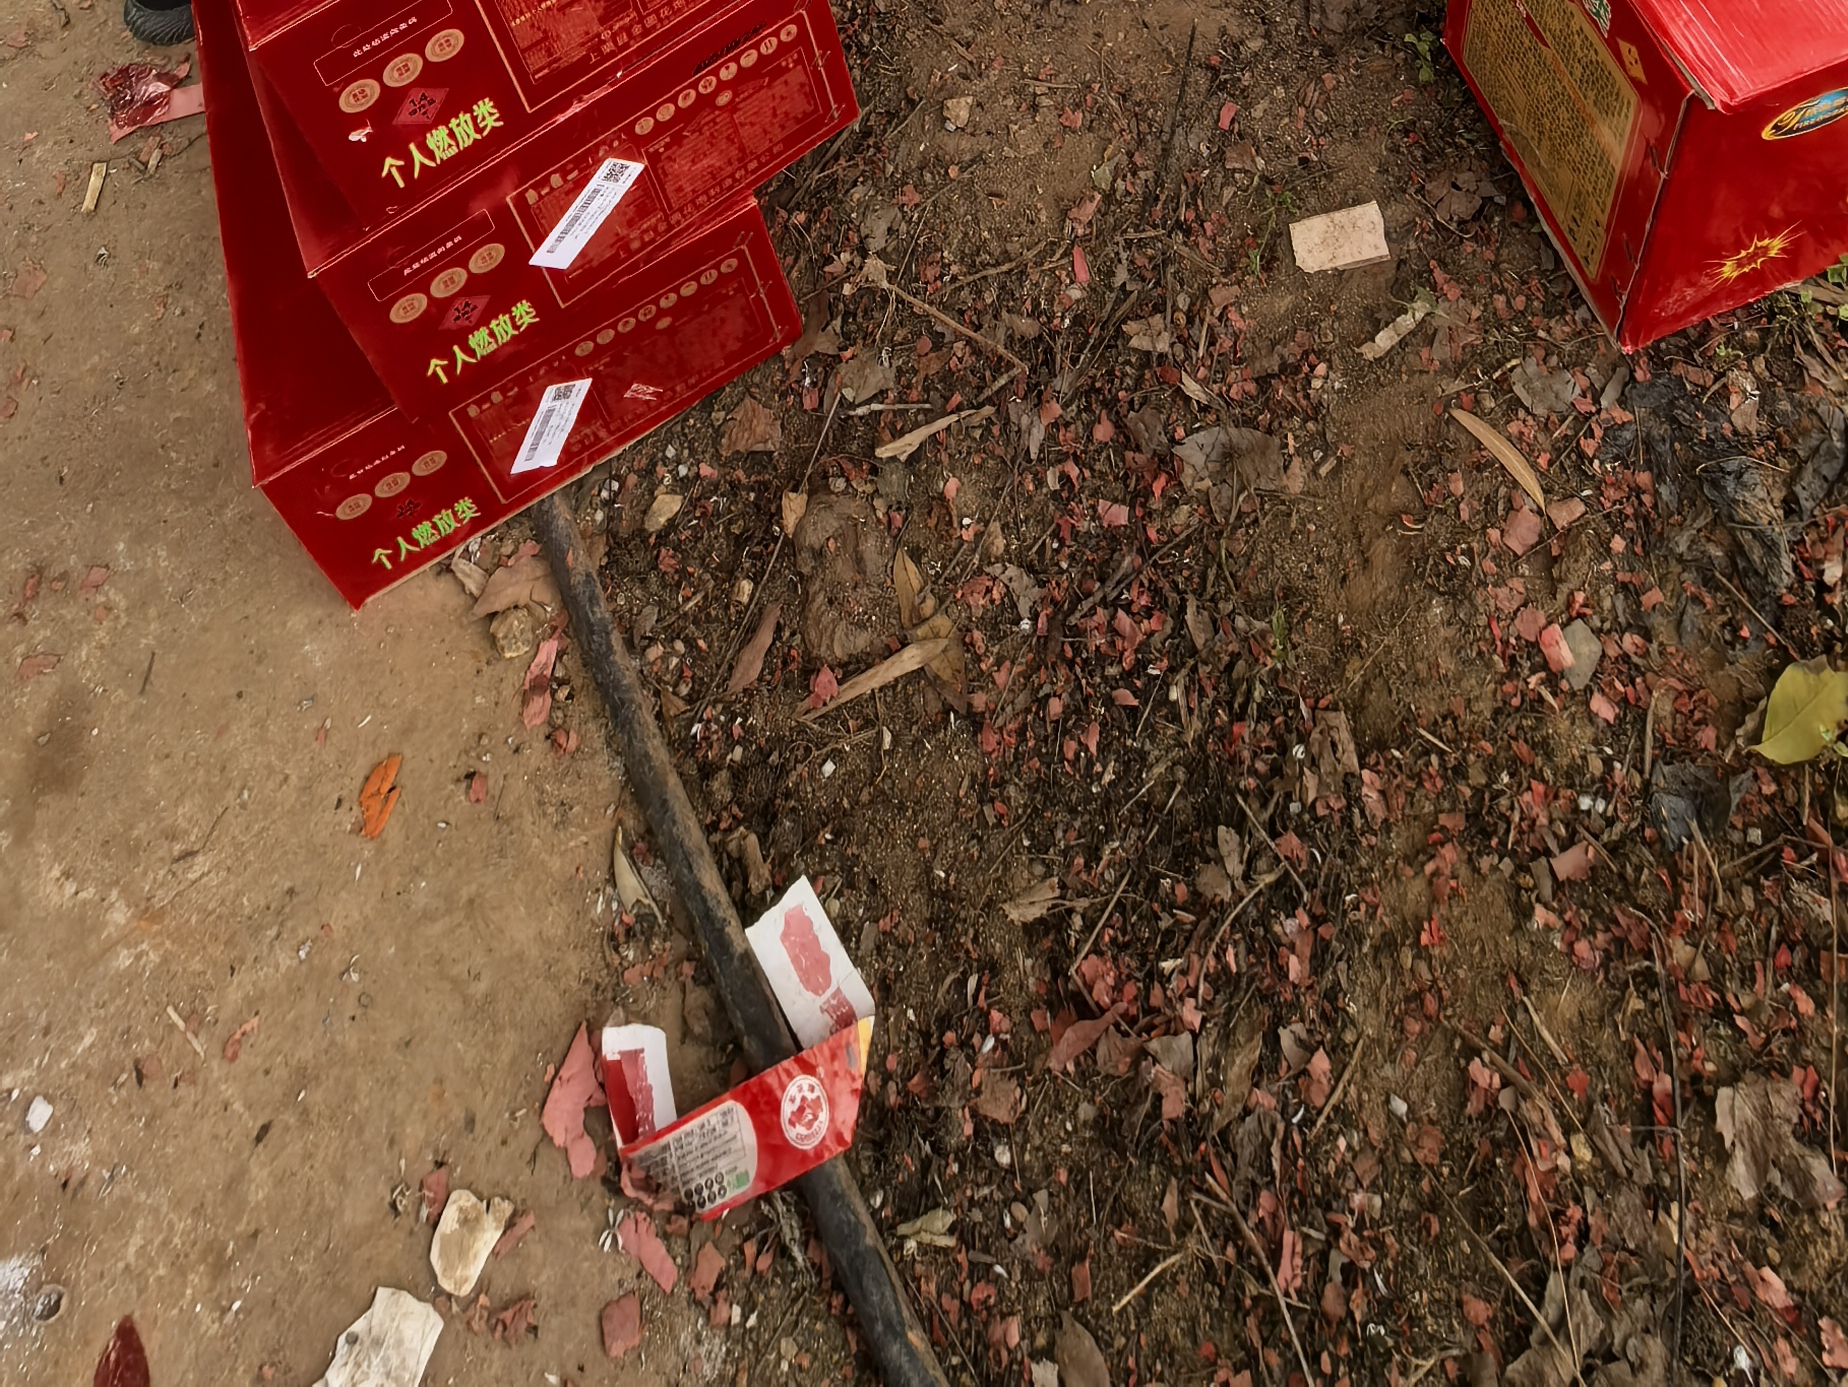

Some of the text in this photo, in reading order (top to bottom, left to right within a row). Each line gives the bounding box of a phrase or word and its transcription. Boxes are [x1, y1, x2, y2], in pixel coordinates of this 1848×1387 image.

[380, 98, 504, 190] 个人燃放类
[427, 300, 541, 384] 个人燃放类
[371, 497, 482, 571] 个人燃放类
